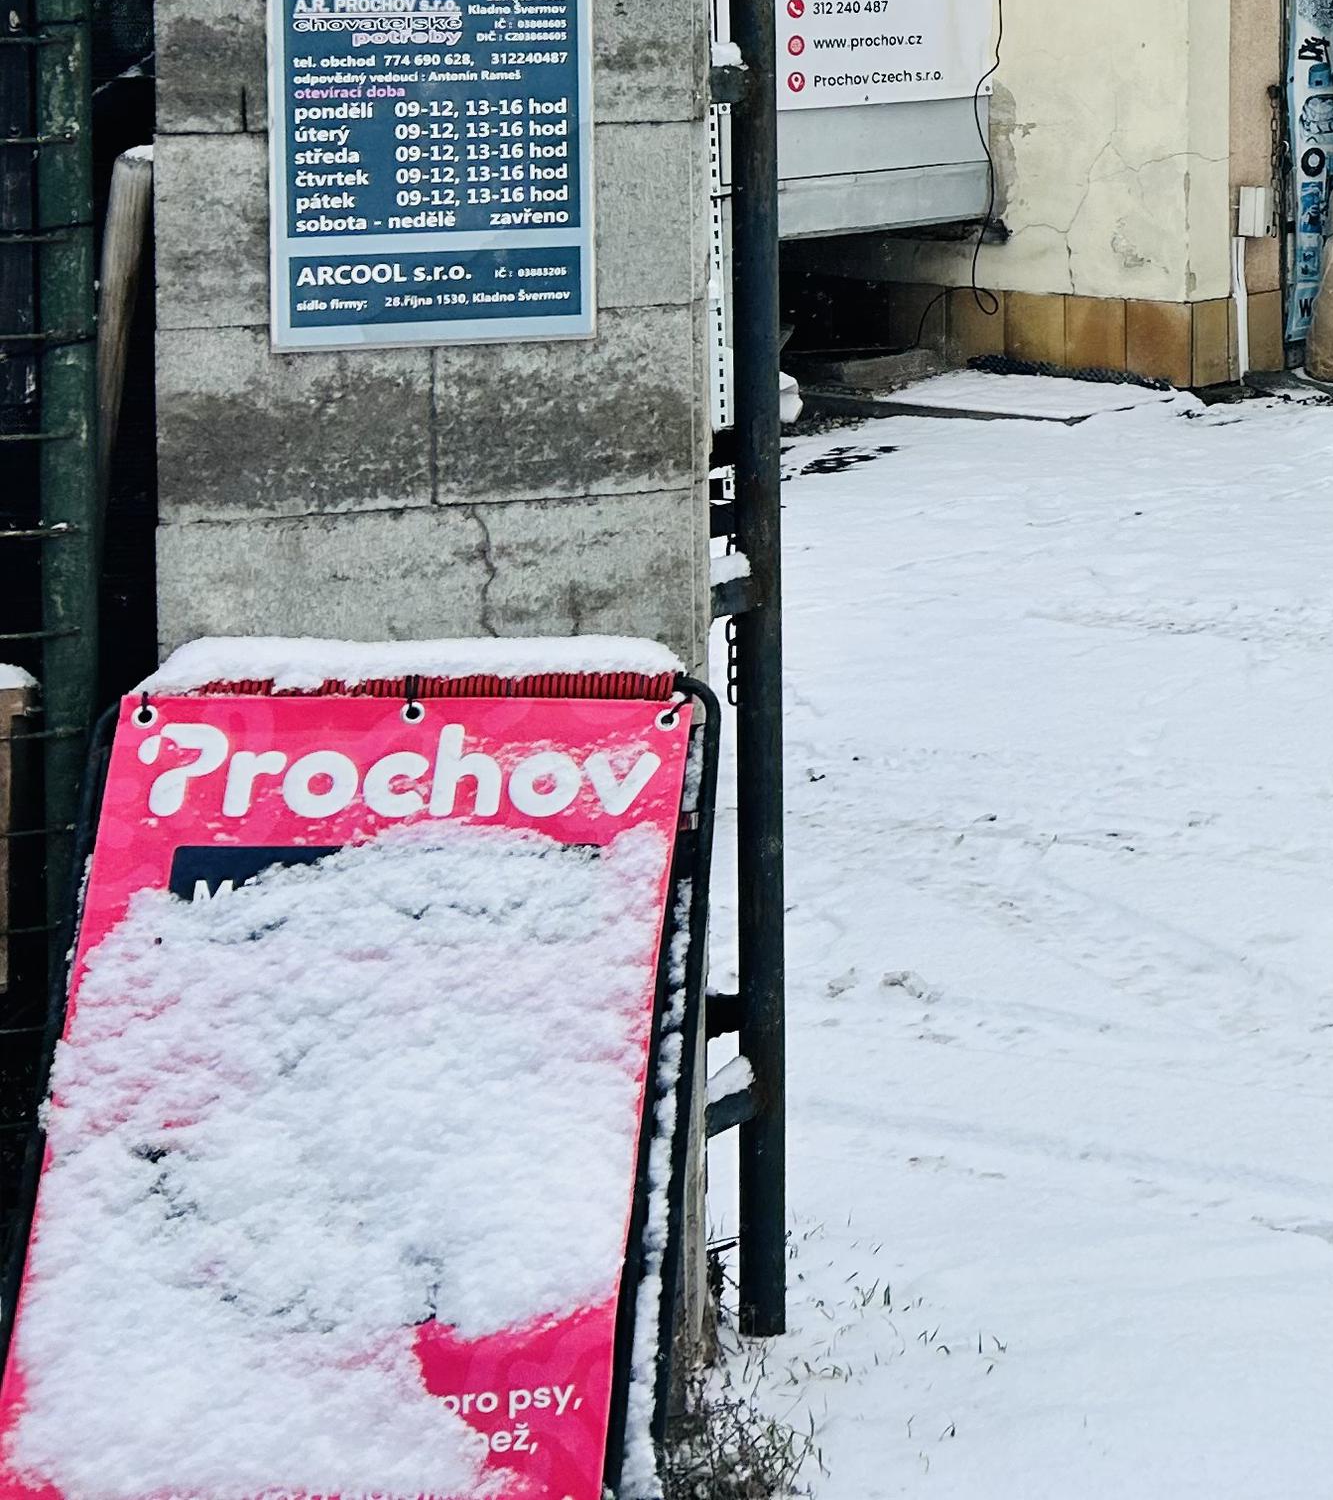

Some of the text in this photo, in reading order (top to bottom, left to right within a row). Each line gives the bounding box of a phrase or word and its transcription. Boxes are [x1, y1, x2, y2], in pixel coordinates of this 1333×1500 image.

[468, 2, 567, 15] Kladno Švermov
[812, 0, 889, 15] 312 240 487
[351, 28, 463, 47] potřeby
[813, 34, 923, 51] www.prochov.cz
[293, 52, 568, 69] tel. obchod 774 690 628, 312240487
[293, 72, 367, 86] odpovědný
[369, 70, 419, 84] vedoucí
[428, 70, 478, 82] Antonín
[481, 68, 521, 81] Rameš
[814, 70, 944, 87] Prochov Czech s.r.o.
[294, 85, 406, 100] otevírací doba
[294, 98, 568, 124] pondělí 09-12, 13-16 hod
[294, 120, 568, 146] úterý 09-12, 13-16 hod
[294, 142, 568, 166] středa 09-12, 13-16 hod
[294, 163, 568, 187] čtvrtek 09-12, 13-16 hod
[296, 185, 568, 214] pátek 09-12, 13-16 hod
[296, 215, 368, 232] sobota
[489, 208, 569, 226] zavřeno
[296, 263, 407, 287] ARCOOL
[413, 265, 473, 282] s.r.o.
[296, 288, 571, 313] sídlo firmy: 28.října 1530, Kladno Švermov
[137, 723, 662, 818] Prochov
[438, 1384, 583, 1420] pro psy,
